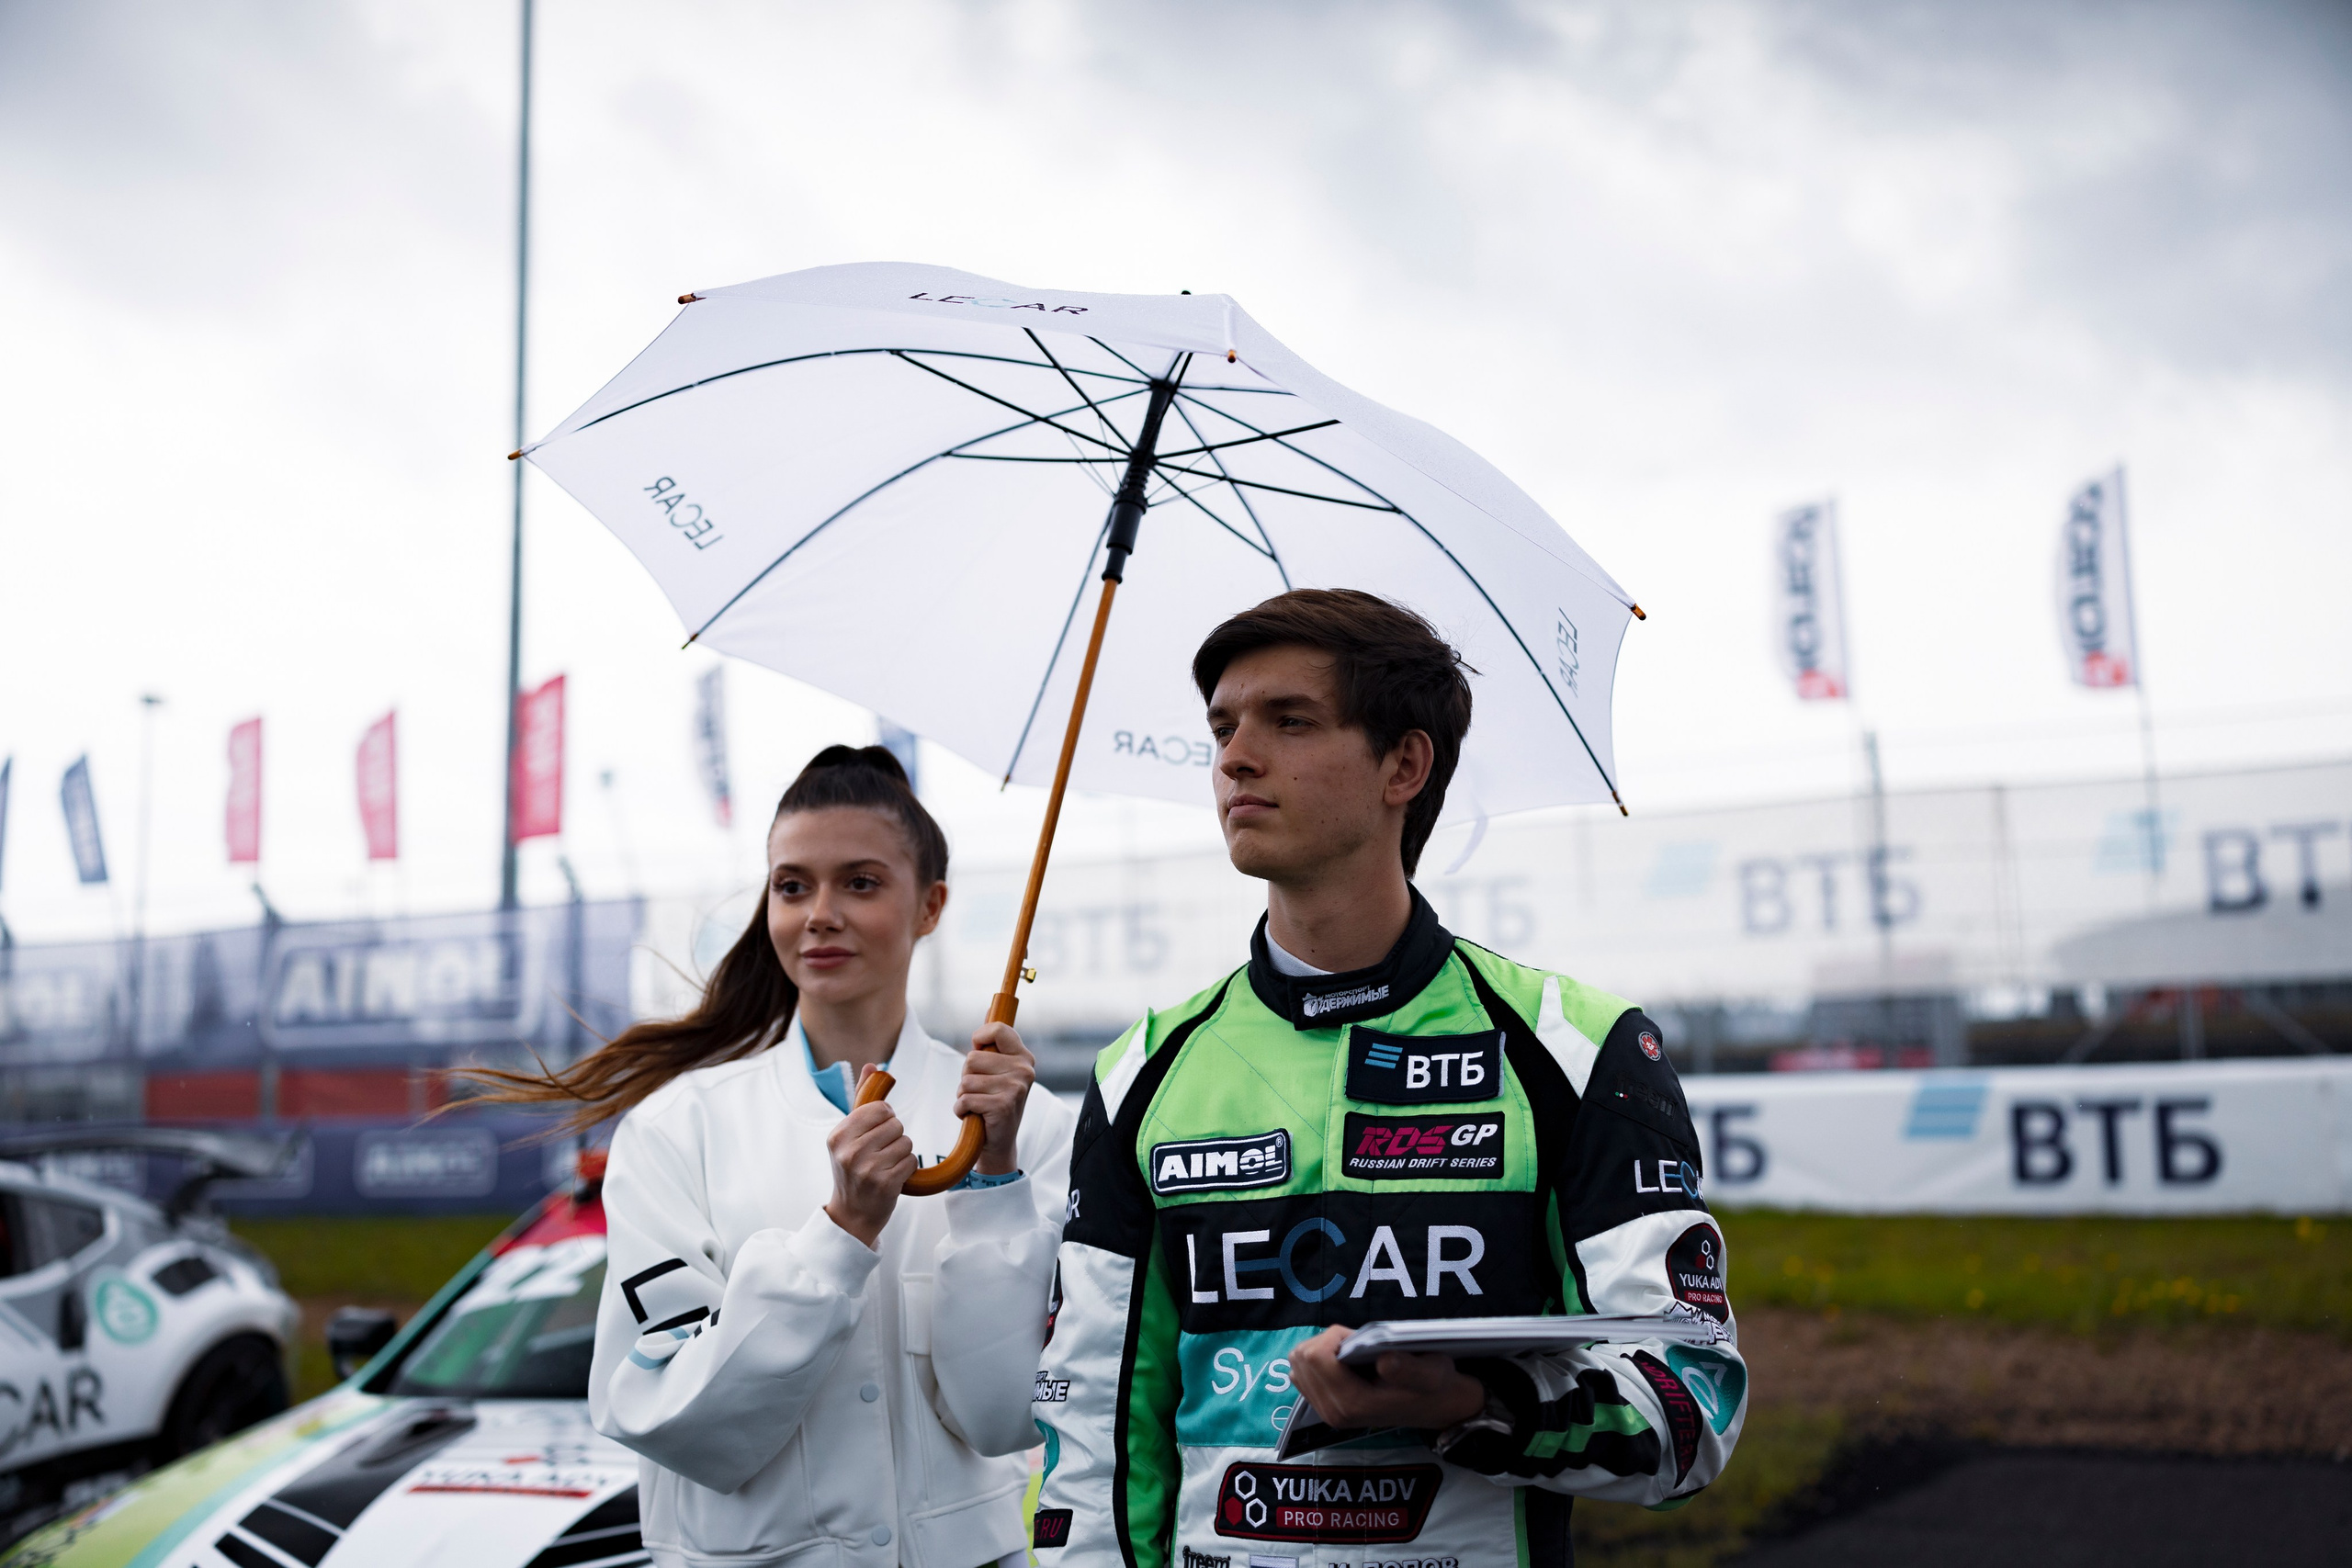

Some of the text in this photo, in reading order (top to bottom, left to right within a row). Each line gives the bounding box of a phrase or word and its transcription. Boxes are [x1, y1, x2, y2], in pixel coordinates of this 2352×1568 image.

[908, 292, 1089, 315] LECAR
[2201, 819, 2352, 915] ВТ
[1738, 845, 1921, 935] ВТБ
[1325, 985, 1371, 999] МОТОРСПОРТ
[1406, 1051, 1485, 1089] ВТБ
[1355, 1123, 1498, 1156] RDS GP
[2011, 1093, 2223, 1185] ВТБ
[1349, 1156, 1497, 1168] RUSSIAN DRIFT SERIES
[1186, 1217, 1485, 1303] LECAR
[1679, 1273, 1710, 1289] YUKA
[1688, 1292, 1702, 1302] PRO
[1358, 1477, 1417, 1502] ADV
[1330, 1512, 1399, 1527] RACING
